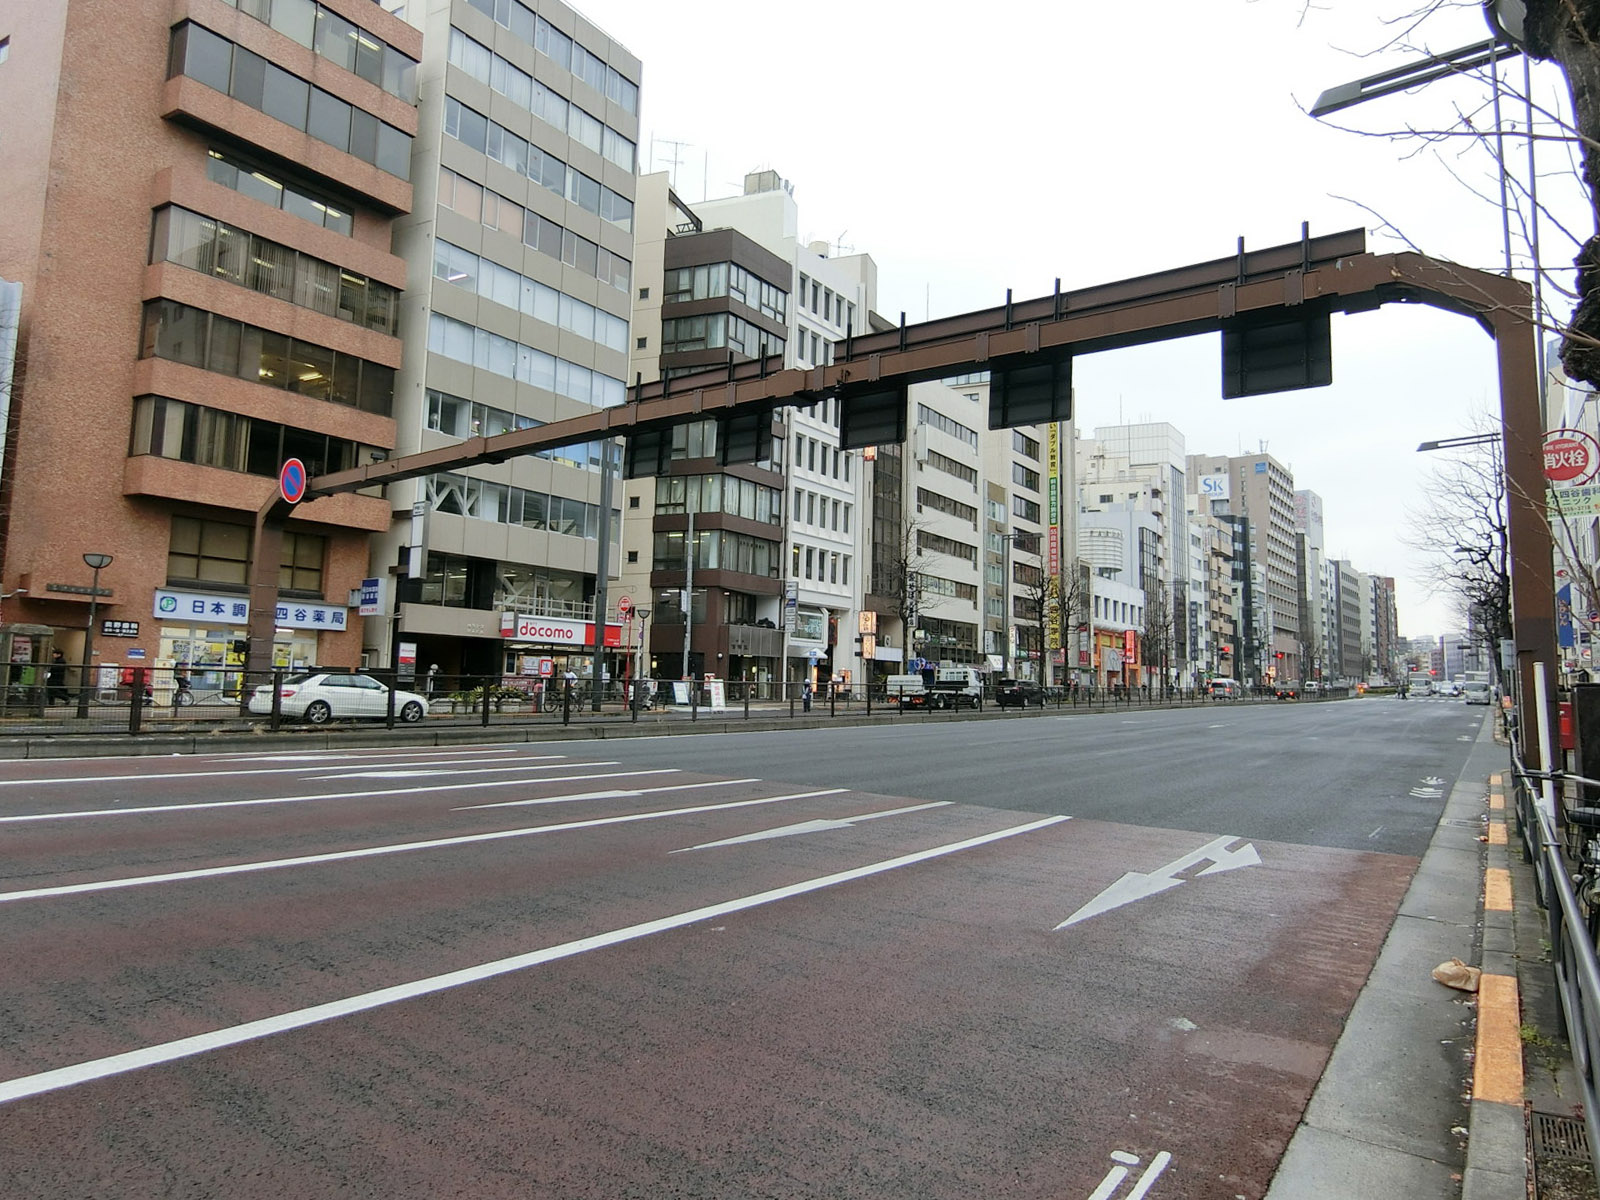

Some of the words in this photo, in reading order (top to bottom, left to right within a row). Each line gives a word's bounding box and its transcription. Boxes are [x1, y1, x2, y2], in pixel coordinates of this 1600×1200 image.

[1544, 449, 1586, 470] 消火栓
[275, 607, 344, 625] 四谷薬局
[520, 622, 574, 639] docomo
